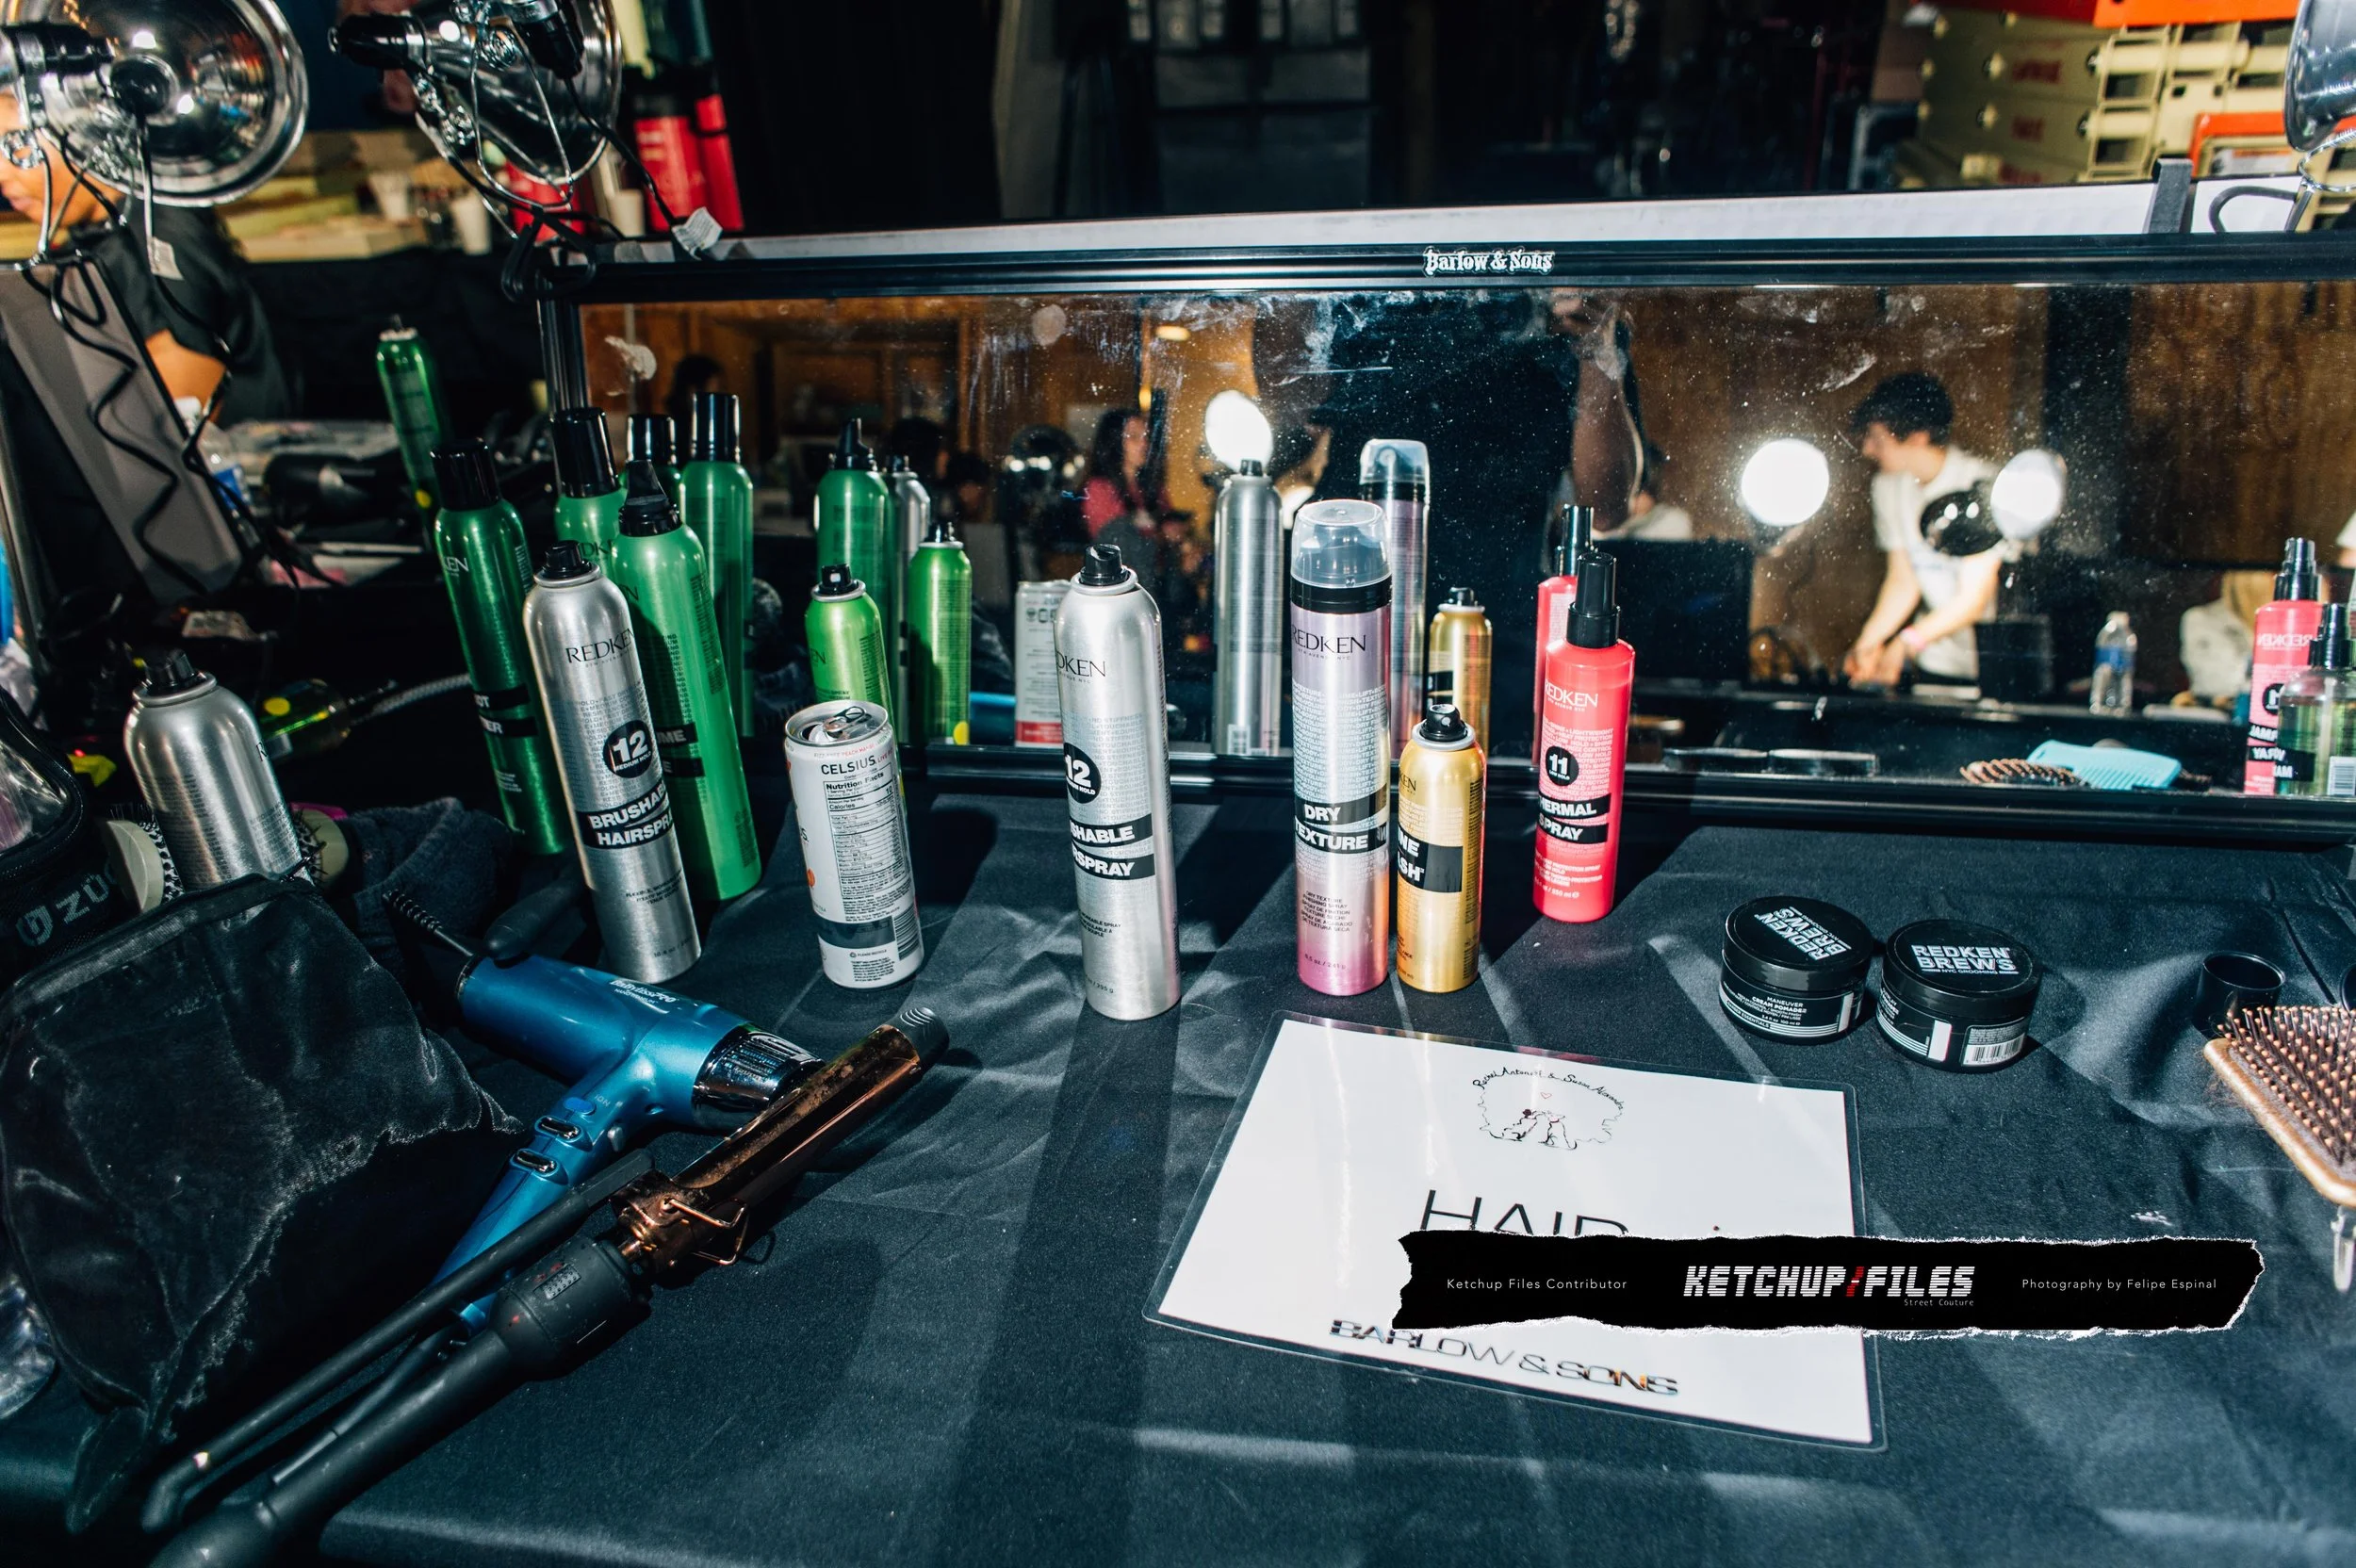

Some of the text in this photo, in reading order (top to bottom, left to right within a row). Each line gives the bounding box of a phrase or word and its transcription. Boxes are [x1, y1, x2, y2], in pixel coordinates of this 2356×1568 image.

[1423, 248, 1555, 275] Barlow & Sons
[613, 730, 649, 762] 12
[821, 755, 875, 775] CELSIUS
[1065, 755, 1091, 787] 12
[1549, 754, 1568, 775] 11
[826, 772, 884, 790] Nutrition Facts
[1079, 785, 1096, 795] HOLD
[1304, 804, 1341, 821] DRY
[1754, 912, 1830, 960] REDKEN
[1774, 908, 1847, 956] BREWS
[1911, 944, 2010, 958] REDKEN
[1917, 956, 2016, 971] BREWS
[1752, 996, 1774, 1007] CREAM
[1767, 996, 1804, 1007] MANEUVER
[1330, 1319, 1679, 1396] BARLOW & SONS
